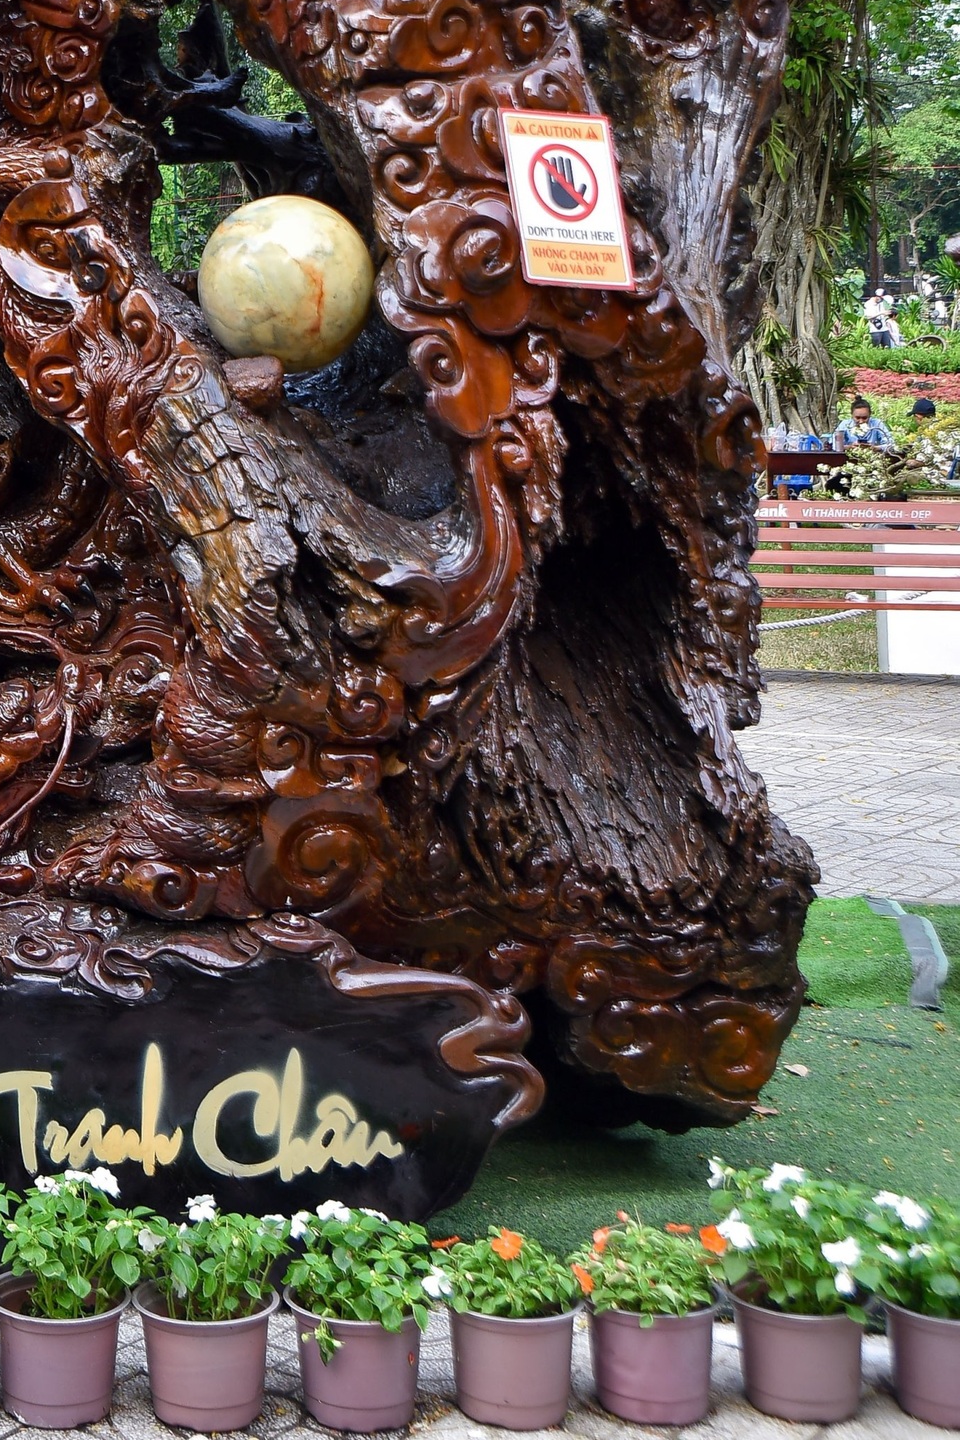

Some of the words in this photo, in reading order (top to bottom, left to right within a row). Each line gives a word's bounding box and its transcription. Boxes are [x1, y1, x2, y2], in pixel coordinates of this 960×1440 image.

[529, 124, 581, 138] CAUTION
[527, 225, 554, 238] DON'T
[556, 228, 588, 240] TOUCH
[591, 231, 616, 242] HERE
[532, 246, 567, 259] KHÔNG
[569, 250, 599, 263] CHẠM
[601, 252, 617, 263] TAY
[814, 507, 850, 518] THÀNH
[195, 1051, 406, 1182] Châu
